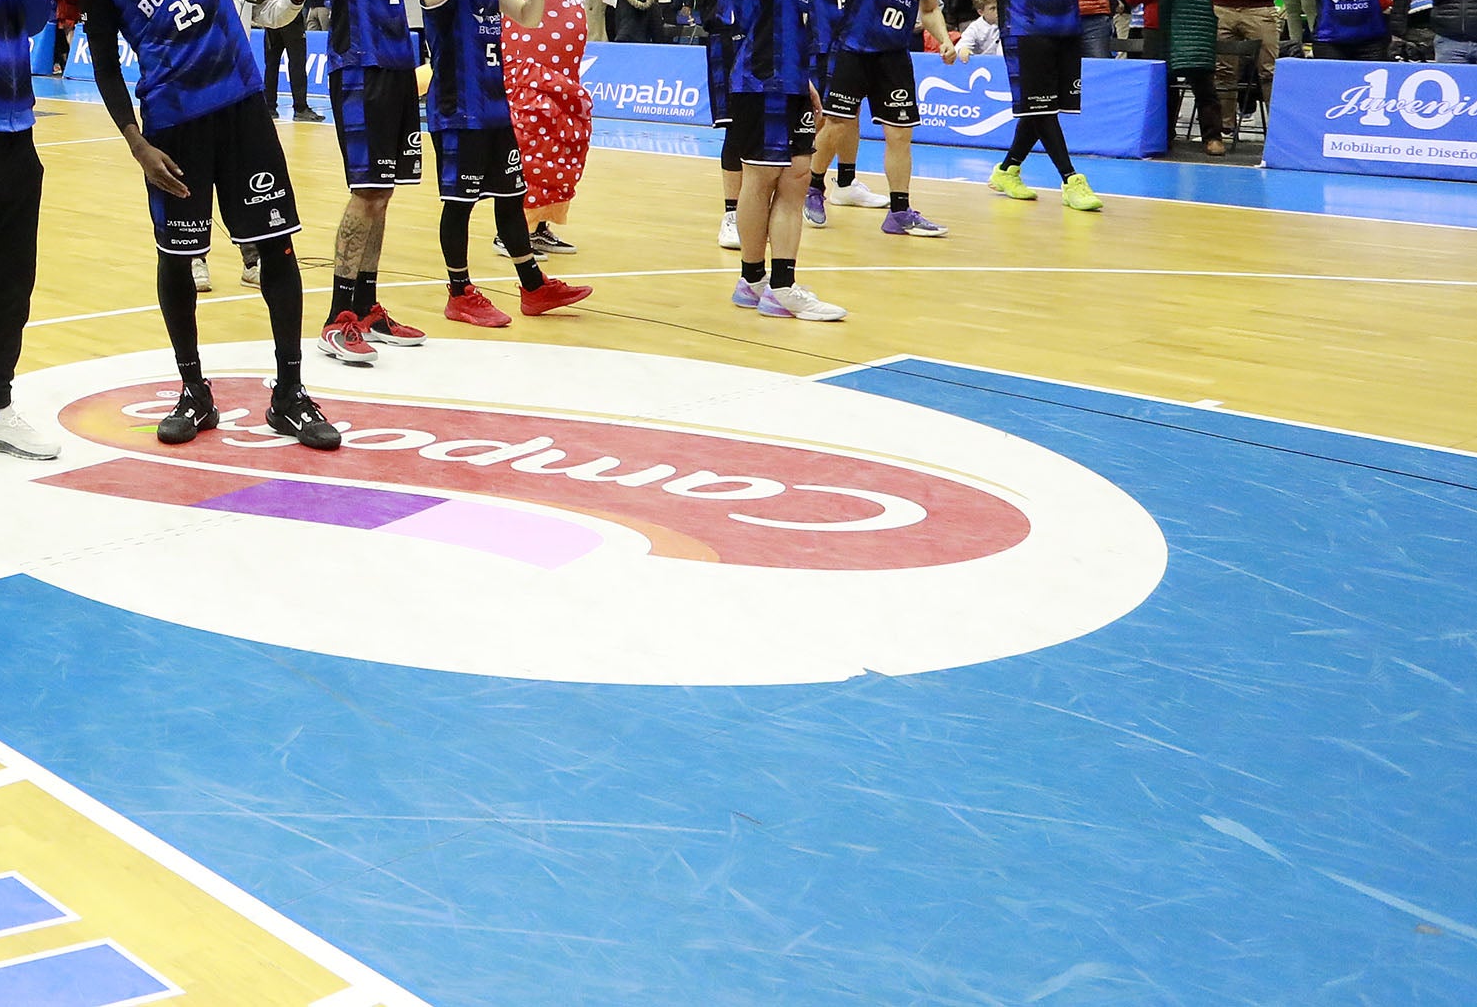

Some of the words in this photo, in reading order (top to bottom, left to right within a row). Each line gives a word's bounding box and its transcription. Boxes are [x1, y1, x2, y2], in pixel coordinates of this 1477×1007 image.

[882, 6, 905, 30] 00
[1359, 68, 1460, 130] 10
[633, 105, 696, 117] INMOBILIARIA
[919, 103, 981, 119] BURGOS
[1330, 141, 1401, 155] Mobiliario
[1406, 146, 1423, 157] de
[1428, 147, 1477, 160] Diseño
[243, 189, 287, 206] LEXUS
